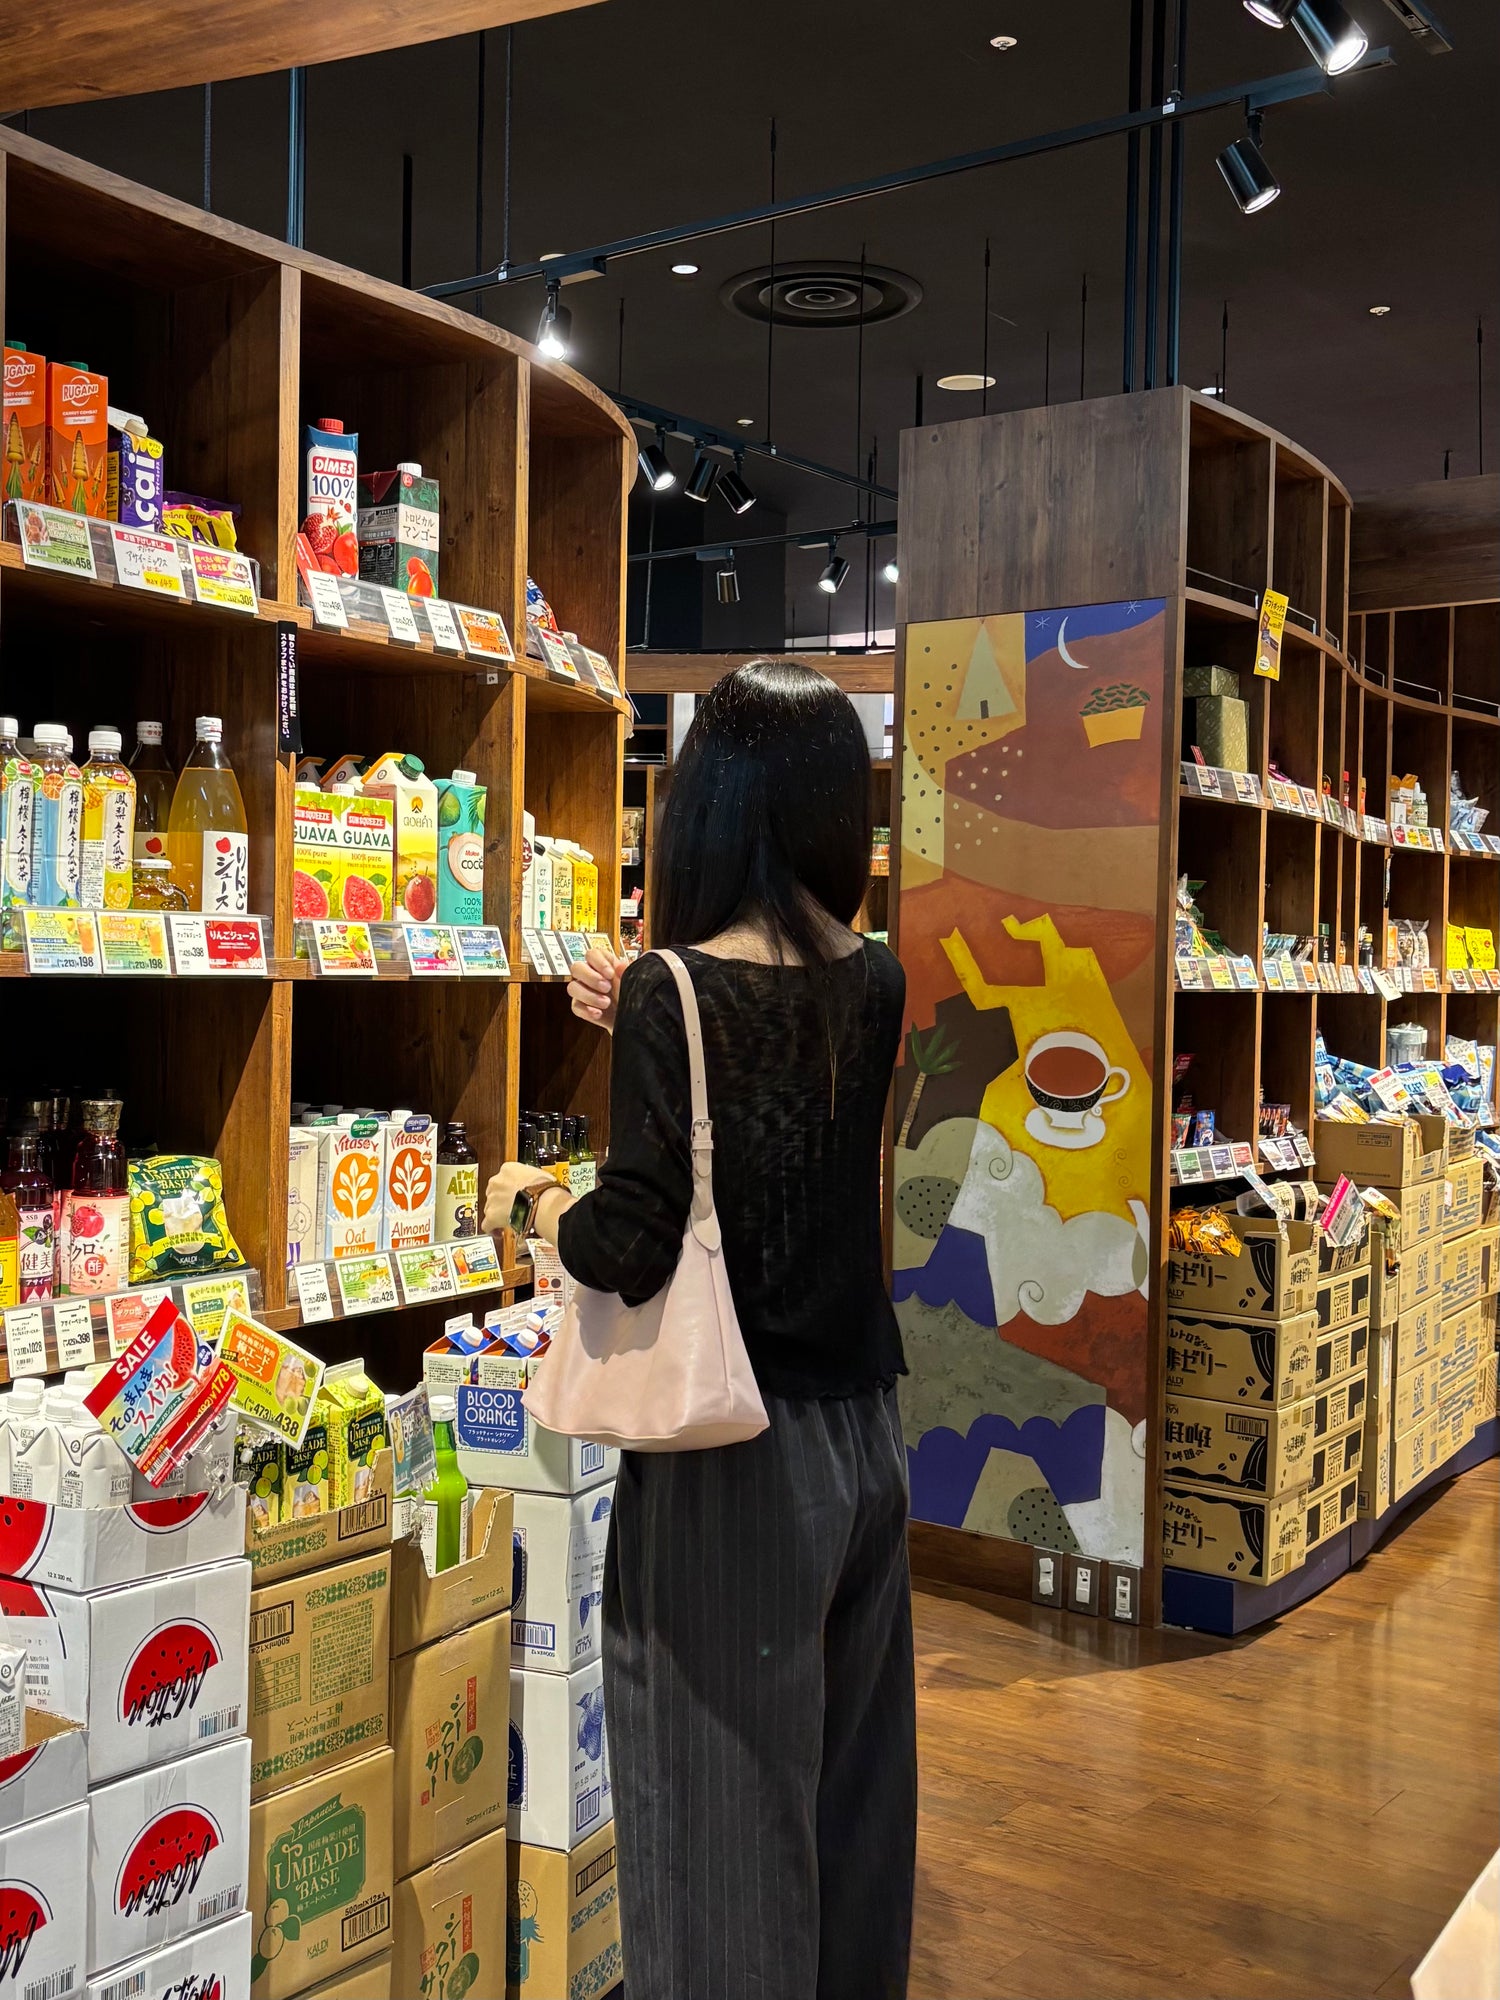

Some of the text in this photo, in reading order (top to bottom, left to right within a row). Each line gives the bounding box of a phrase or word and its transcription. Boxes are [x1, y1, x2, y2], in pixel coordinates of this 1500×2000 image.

[62, 384, 99, 402] RUGANI
[312, 475, 355, 500] 100%
[404, 511, 436, 528] トロピカル
[402, 525, 437, 541] マンゴー
[75, 556, 92, 570] 458
[343, 830, 391, 847] GUAVA
[296, 847, 328, 858] 100% pure
[351, 853, 382, 863] 100% pure
[214, 853, 236, 911] ジュース
[235, 846, 247, 911] りんご
[464, 897, 481, 906] 100%
[454, 906, 482, 915] COCON
[209, 930, 257, 940] りんごジュース
[79, 956, 94, 968] 198
[149, 958, 163, 969] 198
[361, 959, 374, 969] 462
[161, 1180, 188, 1190] BASE
[345, 1228, 366, 1244] Oat
[391, 1218, 431, 1238] Almond
[399, 1237, 424, 1247] Milky
[21, 1251, 52, 1271] 健美
[87, 1261, 102, 1274] 酢
[341, 1263, 371, 1273] 植物由来の
[405, 1264, 420, 1273] ミルク
[343, 1274, 360, 1282] ミルク
[440, 1280, 453, 1290] 428
[381, 1291, 394, 1302] 428
[1168, 1289, 1185, 1297] ALDI
[1333, 1293, 1350, 1308] COFFEE
[1333, 1305, 1349, 1323] JELLY
[116, 1331, 157, 1380] SALE
[236, 1342, 271, 1366] 梅エード
[1333, 1344, 1349, 1361] COFFEE
[239, 1356, 263, 1377] ベース
[1333, 1359, 1348, 1376] JELLY
[1167, 1376, 1184, 1385] ALDI
[109, 1367, 154, 1433] そのまんま
[134, 1363, 179, 1434] スイカ!
[467, 1390, 515, 1410] BLOOD
[1330, 1397, 1346, 1415] COFFEE
[253, 1403, 299, 1438] 473 438
[464, 1406, 518, 1427] ORANGE
[1330, 1412, 1346, 1430] JELLY
[350, 1422, 383, 1444] UMEADE
[353, 1437, 371, 1451] BASE
[293, 1451, 312, 1464] BASE
[1327, 1450, 1343, 1468] COFFEE
[165, 1467, 184, 1481] 00%
[1326, 1463, 1342, 1482] JELLY
[1323, 1501, 1338, 1520] COFFEE
[1322, 1514, 1338, 1536] JELLY
[287, 1700, 344, 1732] 梅エードベース
[274, 1834, 360, 1890] UMEADE
[295, 1867, 340, 1901] BASE
[306, 1938, 329, 1956] KALDI
